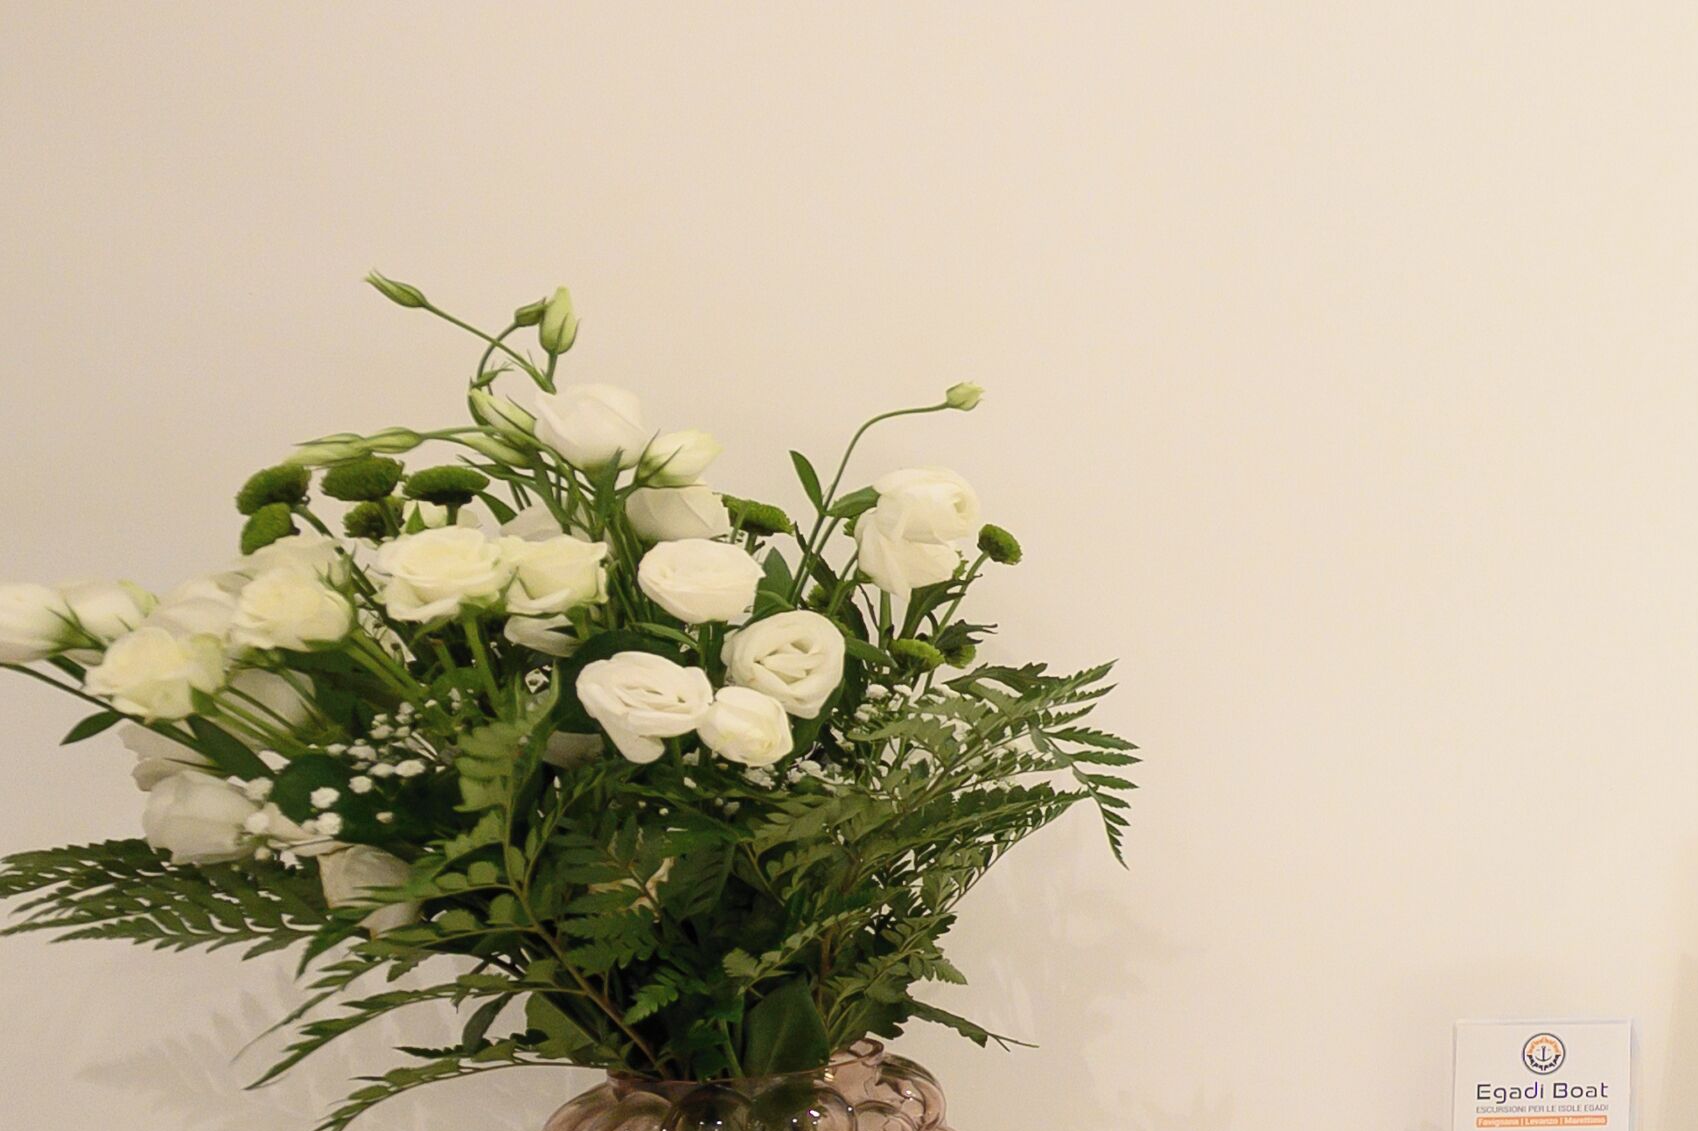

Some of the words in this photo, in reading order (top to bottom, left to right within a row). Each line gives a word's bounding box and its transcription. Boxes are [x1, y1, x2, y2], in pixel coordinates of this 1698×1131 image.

[1476, 1081, 1544, 1105] Egadi
[1553, 1082, 1609, 1099] Boat
[1476, 1105, 1527, 1114] ESCURSIONI
[1528, 1105, 1545, 1113] PER
[1546, 1104, 1556, 1112] LE
[1558, 1104, 1582, 1112] ISOLE
[1584, 1103, 1609, 1112] EGADI
